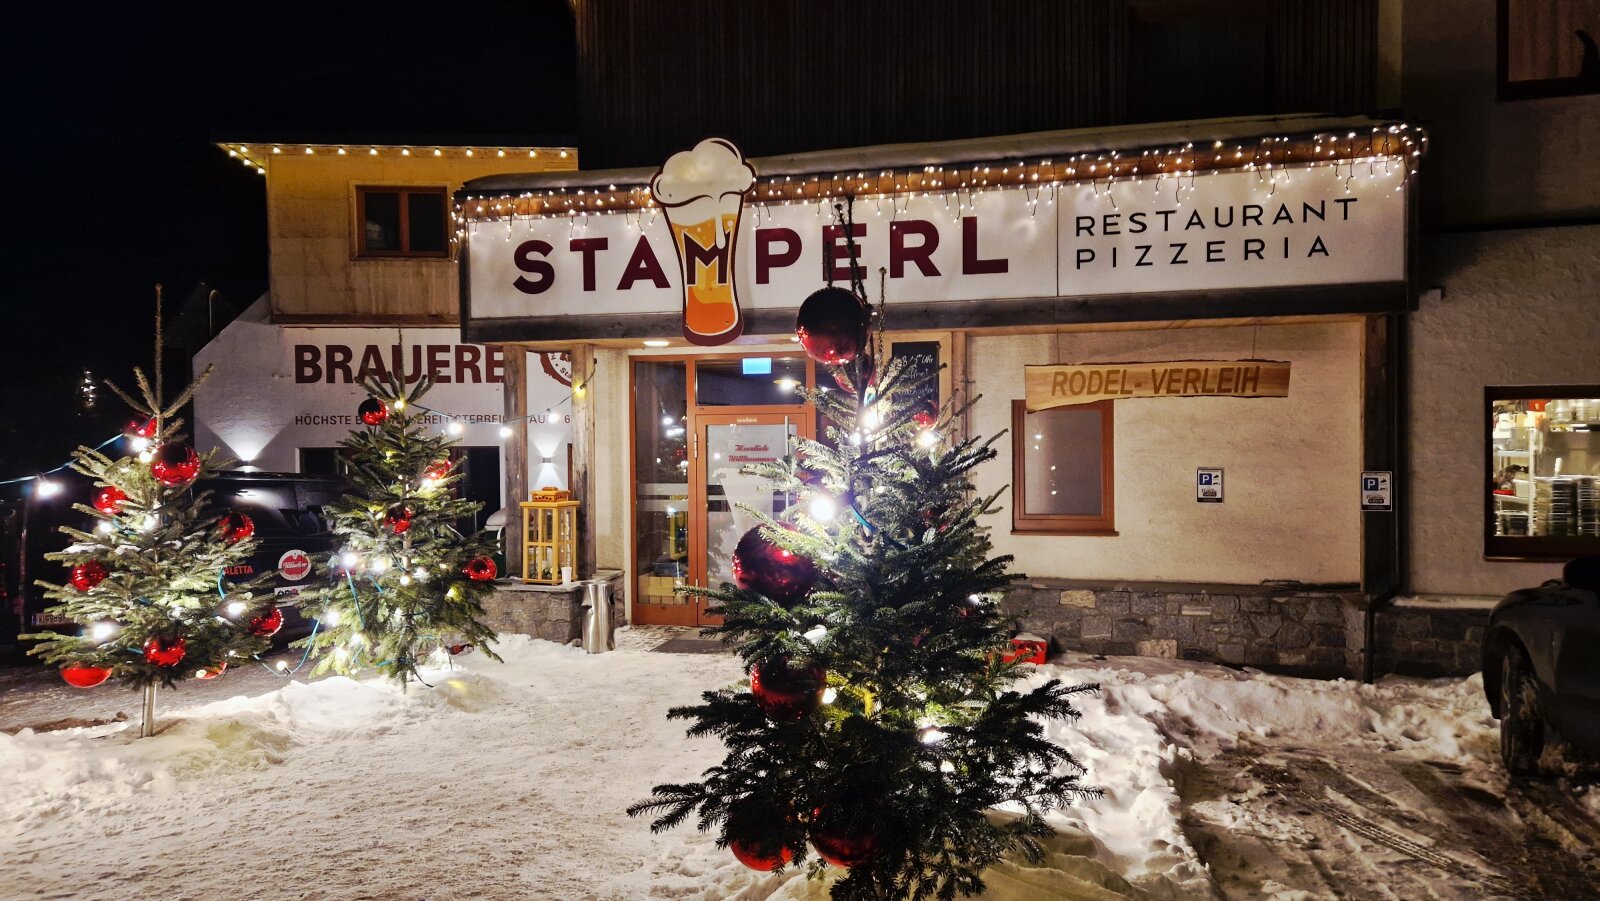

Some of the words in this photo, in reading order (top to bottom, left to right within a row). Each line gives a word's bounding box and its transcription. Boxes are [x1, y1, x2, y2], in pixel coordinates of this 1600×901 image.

[1075, 197, 1358, 237] RESTAURANT
[512, 216, 1009, 295] STAMPERL
[1075, 235, 1330, 270] PIZZERIA
[294, 344, 505, 384] BRAUERE
[1151, 366, 1261, 395] VERLEIH
[295, 413, 351, 426] HÖCHSTE
